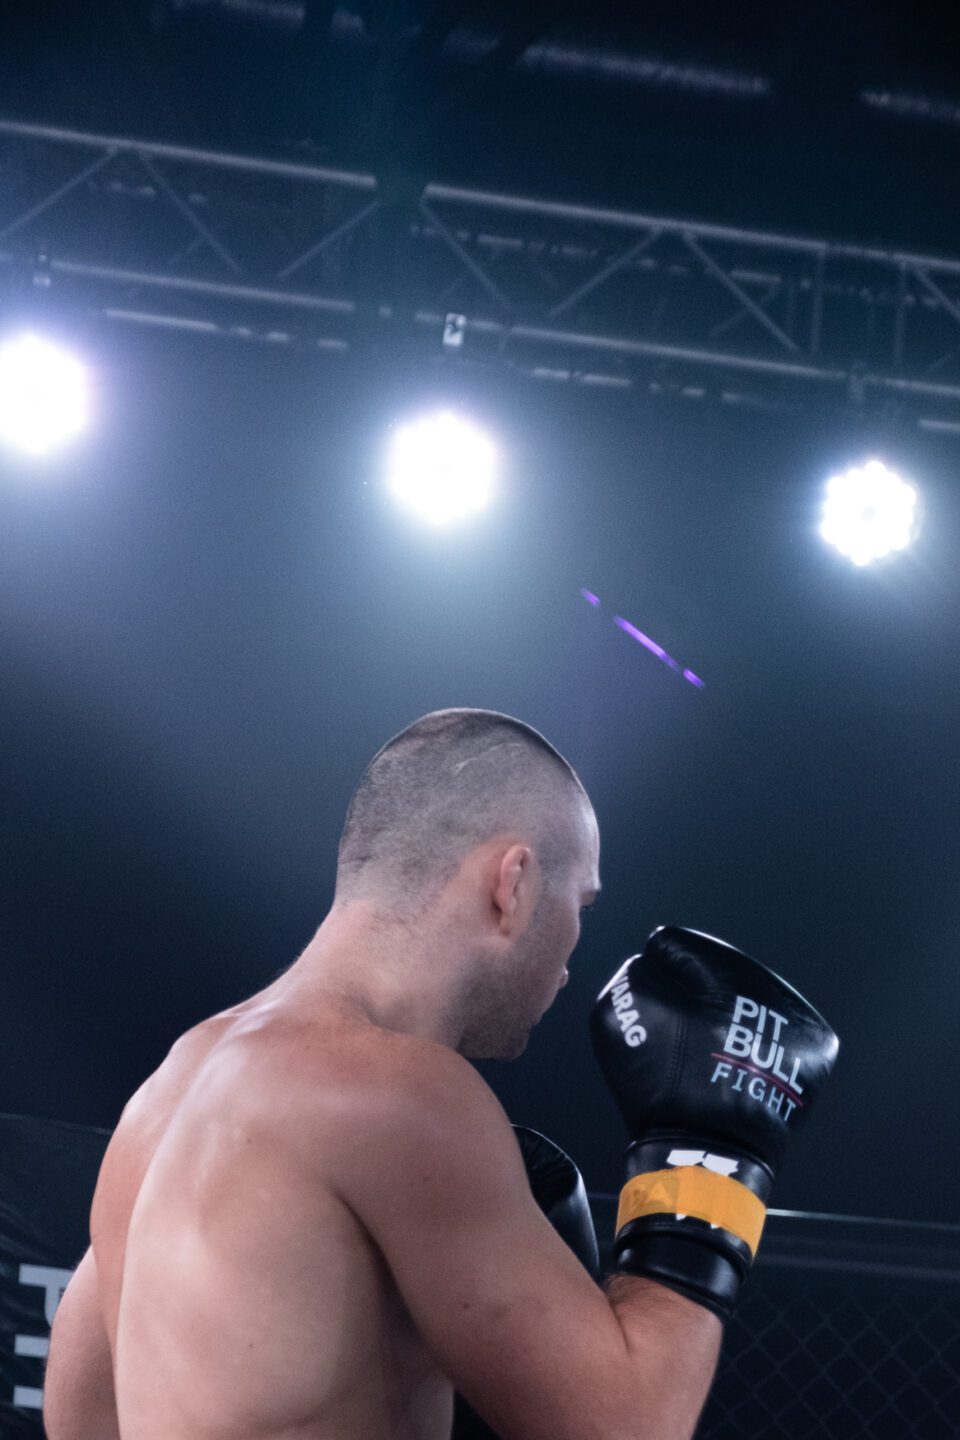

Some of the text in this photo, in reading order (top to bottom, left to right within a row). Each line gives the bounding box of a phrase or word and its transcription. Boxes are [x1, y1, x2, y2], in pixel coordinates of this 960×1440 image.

[732, 995, 789, 1042] PIT
[723, 1023, 803, 1095] BULL
[710, 1062, 797, 1122] FIGHT
